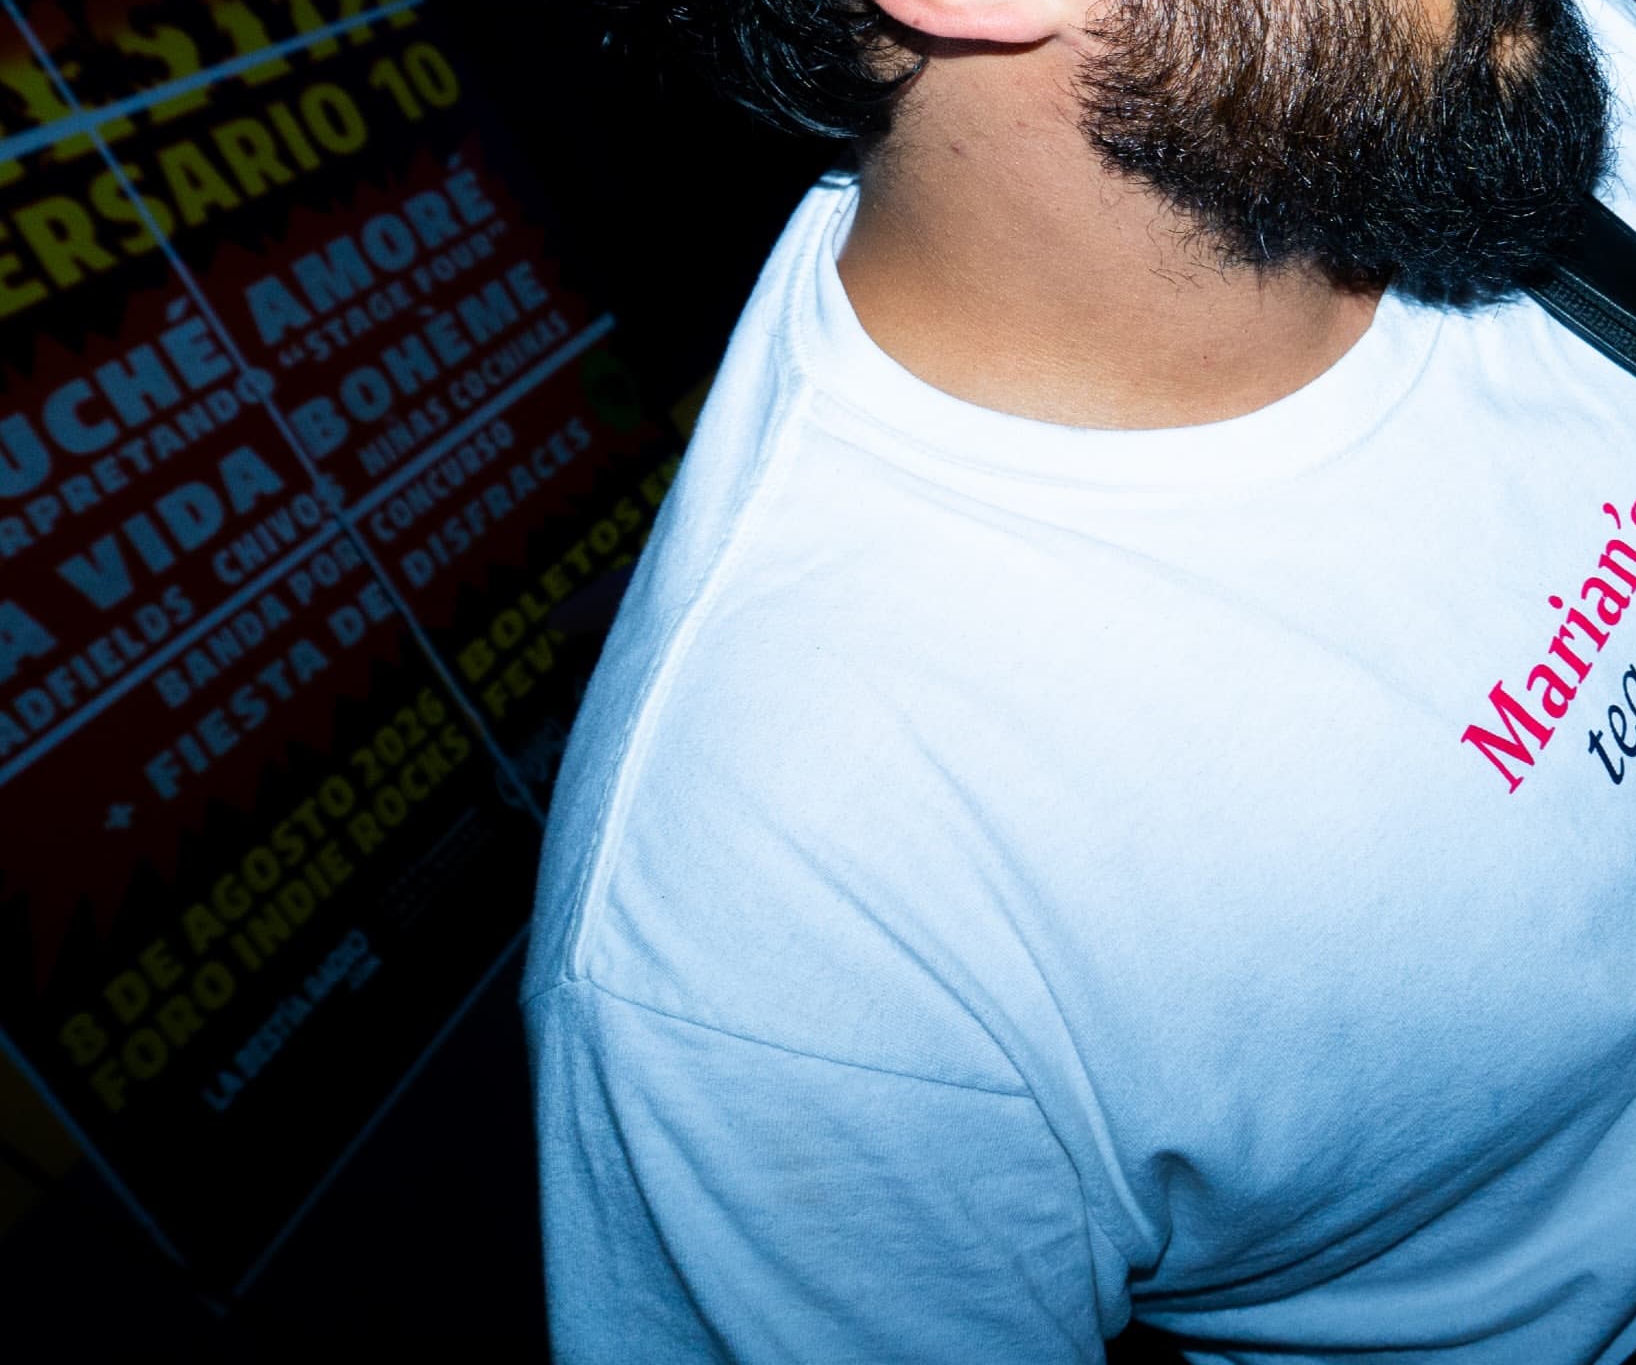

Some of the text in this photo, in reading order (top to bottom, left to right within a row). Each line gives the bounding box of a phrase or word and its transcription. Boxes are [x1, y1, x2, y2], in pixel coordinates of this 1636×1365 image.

[367, 39, 463, 126] 10
[243, 149, 498, 348] AMORÉ
[55, 443, 287, 614] VIDA
[142, 635, 332, 802] FIESTA
[325, 576, 399, 650] DE
[399, 413, 595, 590] DISFRACES
[151, 417, 516, 710] BANDA POR CONCURSO
[455, 495, 645, 687] BOLETOS
[87, 958, 240, 1116] FORO
[227, 841, 357, 975] INDIE
[344, 719, 474, 858] ROCKS
[100, 935, 185, 1027] DE
[179, 772, 360, 957] AGOSTO
[349, 684, 451, 789] 2026
